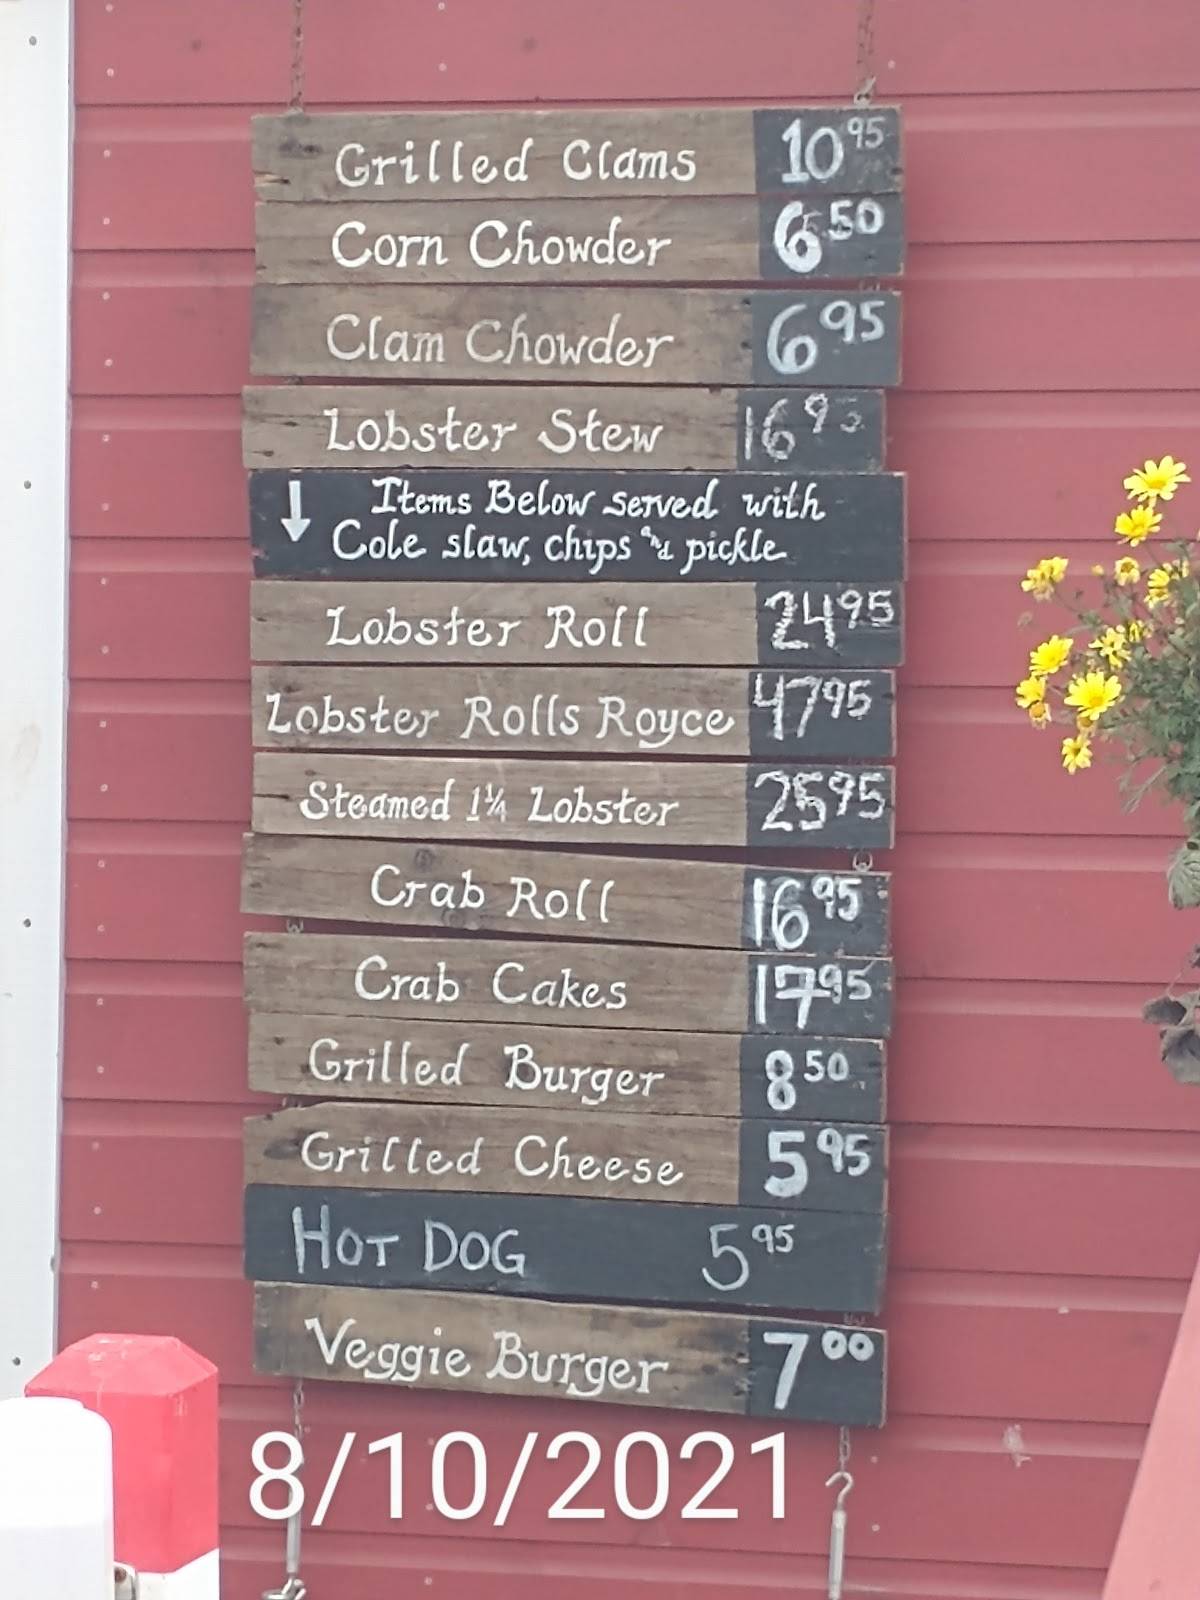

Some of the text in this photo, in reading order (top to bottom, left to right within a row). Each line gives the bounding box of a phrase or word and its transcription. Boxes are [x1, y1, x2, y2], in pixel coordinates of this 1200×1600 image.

[334, 137, 533, 189] Grilled
[561, 139, 699, 184] Clams
[330, 221, 445, 269] Corn
[468, 216, 673, 269] Chowder
[325, 312, 446, 364] Clam
[464, 311, 676, 370] Chowder
[323, 406, 518, 454] Lobster
[537, 406, 664, 454] Stew
[371, 477, 827, 521] Items Below served with
[331, 519, 427, 562] Cole
[543, 530, 633, 576] chips
[679, 526, 789, 578] pickle
[325, 606, 521, 648] Lobster
[543, 604, 650, 650] Roll
[264, 692, 440, 738] Lobster
[458, 694, 581, 740] Rolls
[596, 697, 736, 749] Royce
[298, 776, 453, 825] Steamed
[527, 784, 680, 827] Lobster
[369, 863, 486, 910] Crab
[505, 875, 616, 925] Roll
[354, 954, 460, 1003] Crab
[491, 961, 628, 1011] Cakes
[307, 1037, 471, 1086] Grilled
[503, 1043, 666, 1107] Burger
[300, 1130, 484, 1175] Grilled
[514, 1135, 685, 1187] Cheese
[291, 1203, 401, 1275] HOT
[422, 1218, 527, 1279] DOG
[303, 1316, 472, 1383] Veggie
[485, 1330, 671, 1397] Burger
